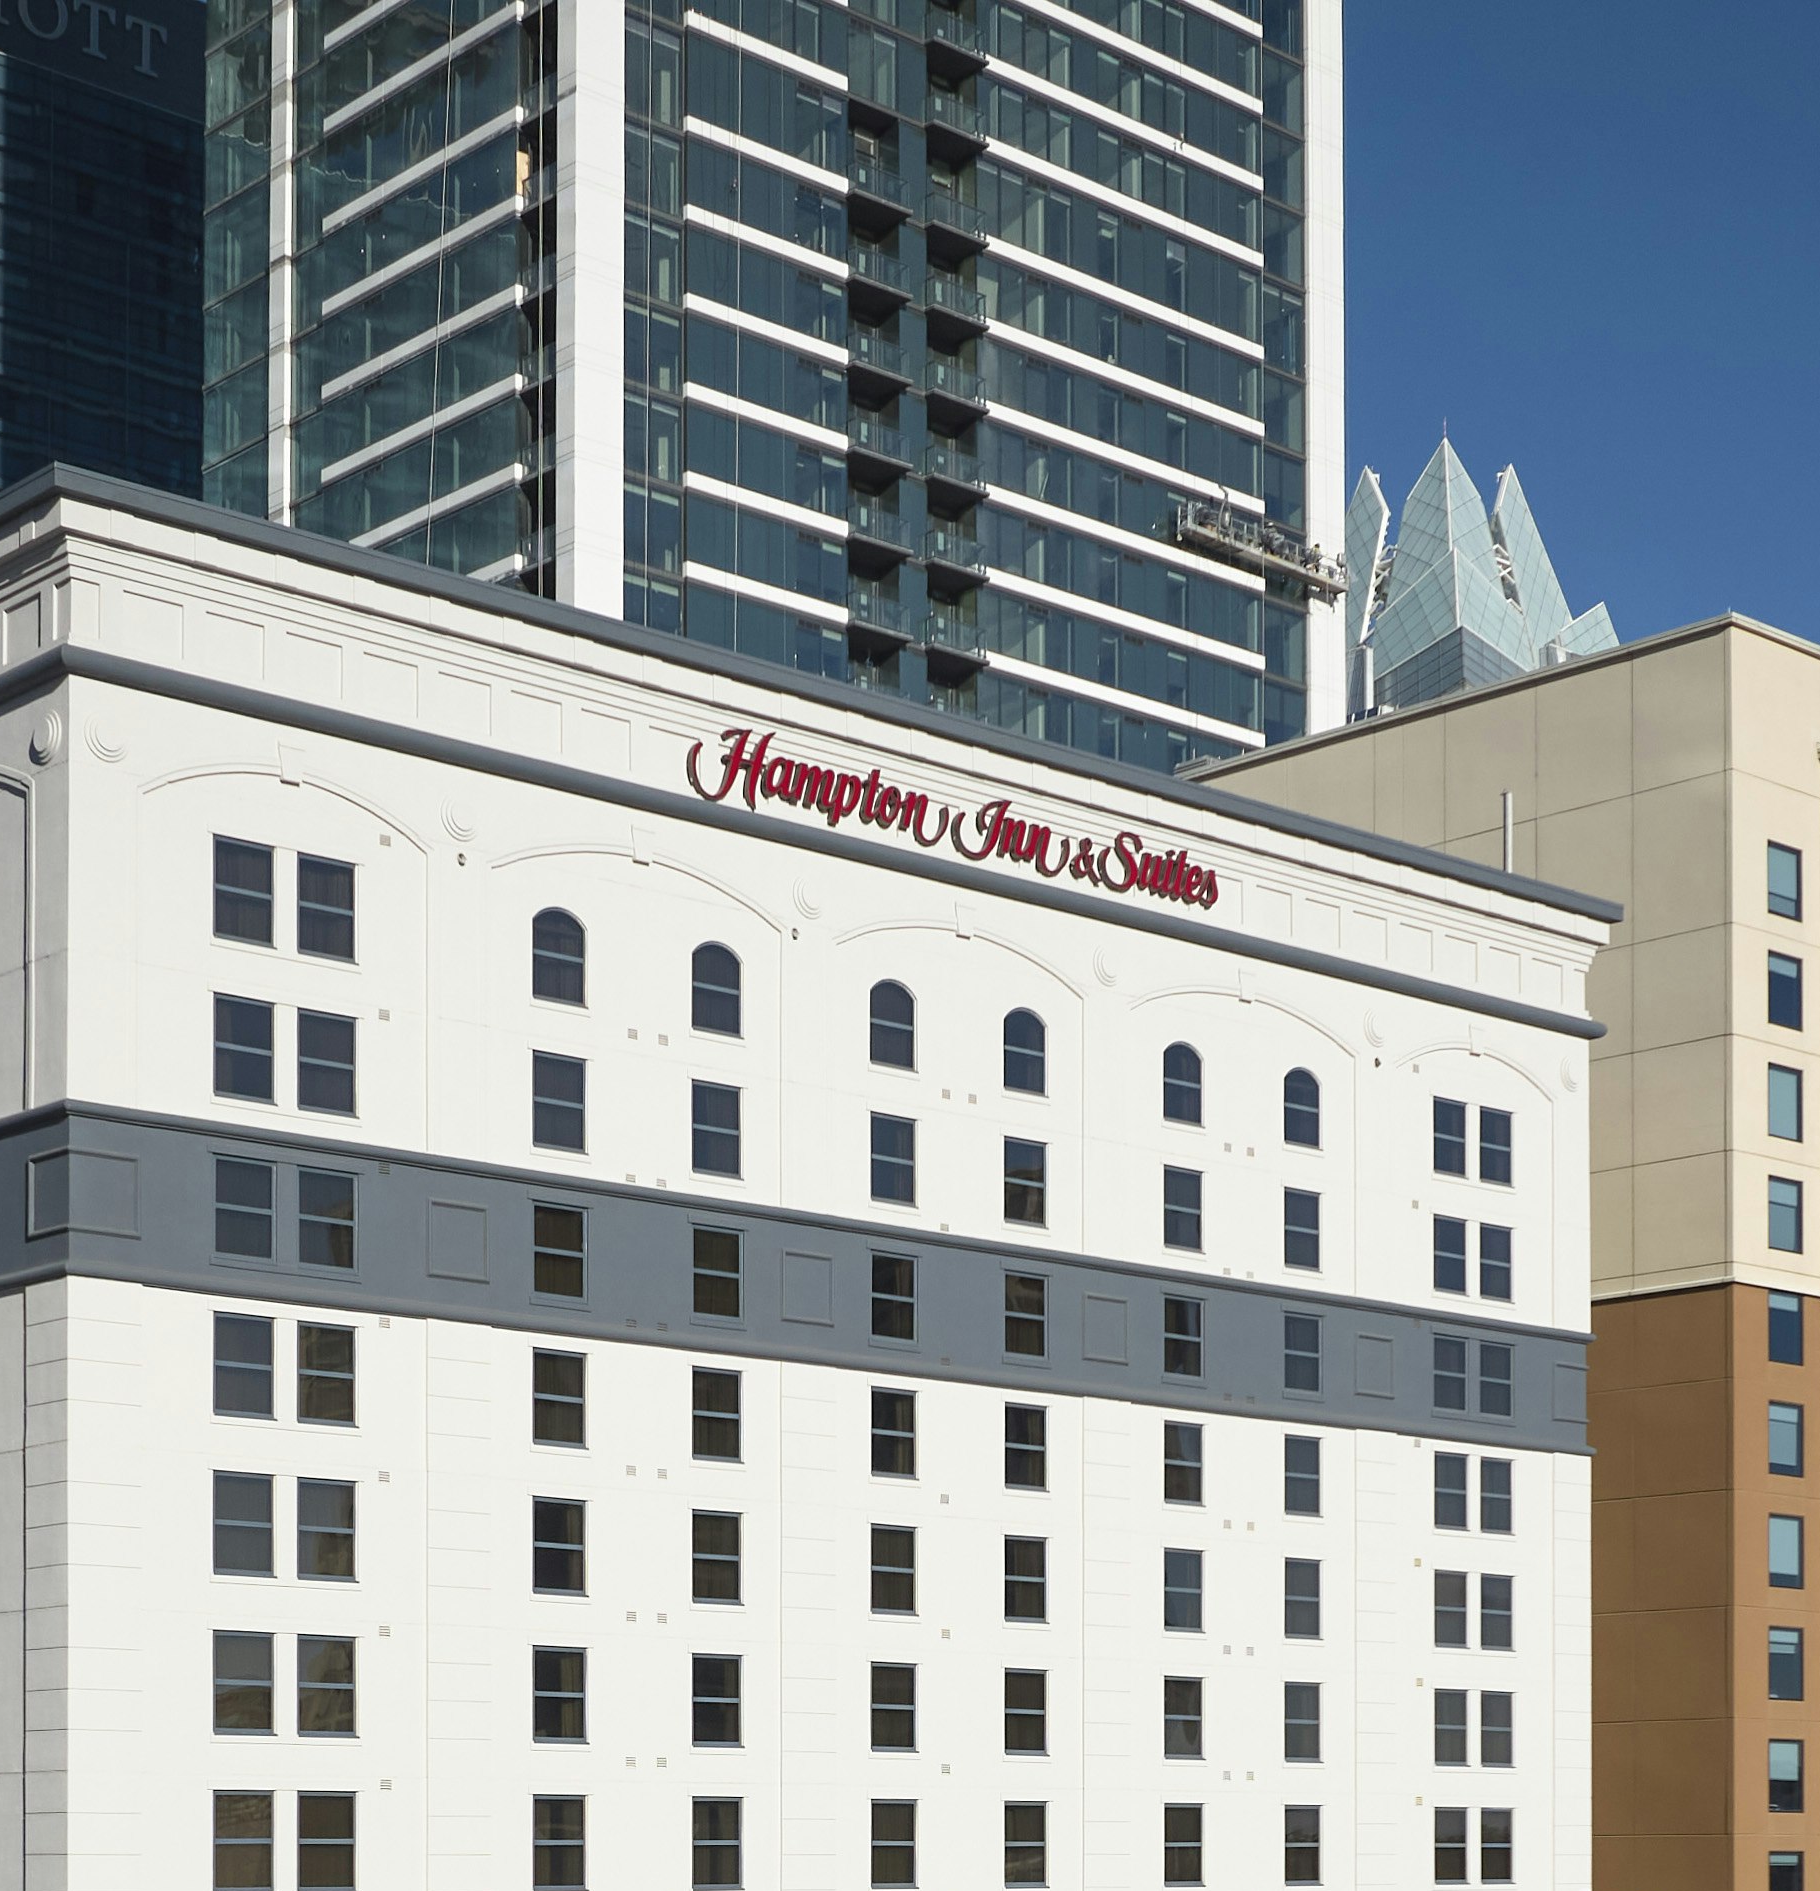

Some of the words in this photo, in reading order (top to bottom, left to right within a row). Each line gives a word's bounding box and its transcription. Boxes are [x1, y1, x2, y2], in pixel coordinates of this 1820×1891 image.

[686, 729, 949, 847] Hampton
[952, 800, 1070, 878] Inn
[1096, 831, 1219, 910] Suites
